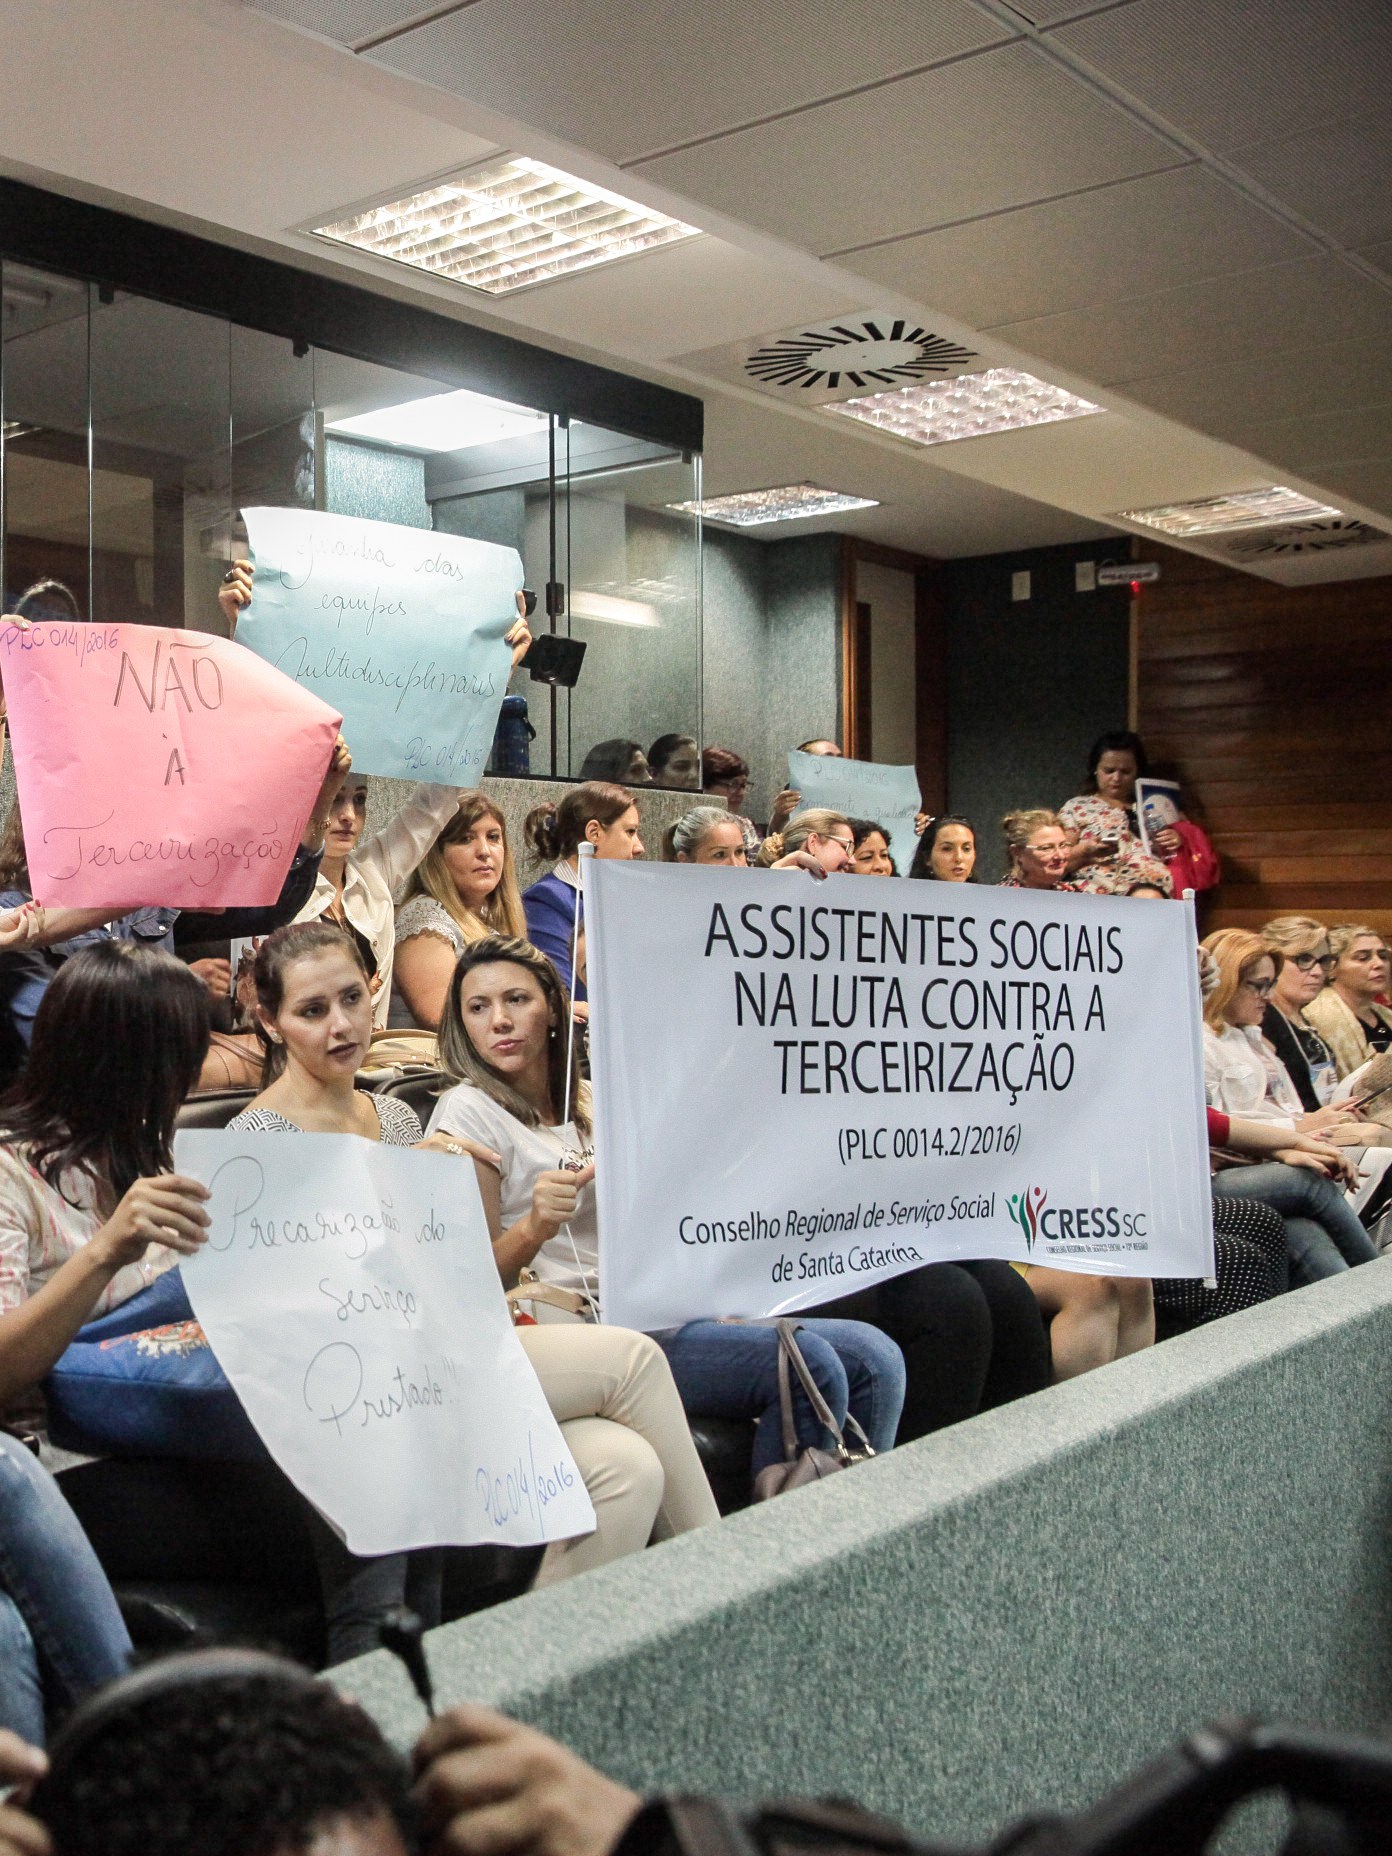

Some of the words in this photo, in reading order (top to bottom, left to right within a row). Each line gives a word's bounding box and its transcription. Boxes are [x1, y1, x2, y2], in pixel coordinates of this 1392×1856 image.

[414, 553, 463, 582] das
[314, 586, 407, 636] equipes
[0, 627, 44, 655] PLC
[51, 625, 119, 668] 014/2016
[113, 640, 225, 713] NÃO
[162, 733, 186, 786] À
[704, 902, 980, 968] ASSISTENTES
[990, 918, 1125, 974] SOCIAIS
[734, 972, 798, 1028] NA
[811, 973, 908, 1030] LUTA
[921, 978, 1073, 1032] CONTRA
[1084, 984, 1106, 1032] A
[773, 1033, 1075, 1106] TERCEIRIZAÇÃO
[838, 1127, 888, 1165] (PLC
[892, 1123, 1022, 1160] 0014.2/2016)
[415, 1208, 446, 1244] do
[678, 1210, 780, 1248] Conselho
[785, 1203, 860, 1242] Regional
[863, 1201, 883, 1228] de
[887, 1197, 944, 1227] Serviço
[948, 1192, 996, 1220] Social
[1040, 1206, 1121, 1240] CRESS
[1122, 1213, 1147, 1237] SC
[771, 1255, 794, 1284] de
[798, 1250, 843, 1278] Santa
[847, 1242, 923, 1273] Catarina
